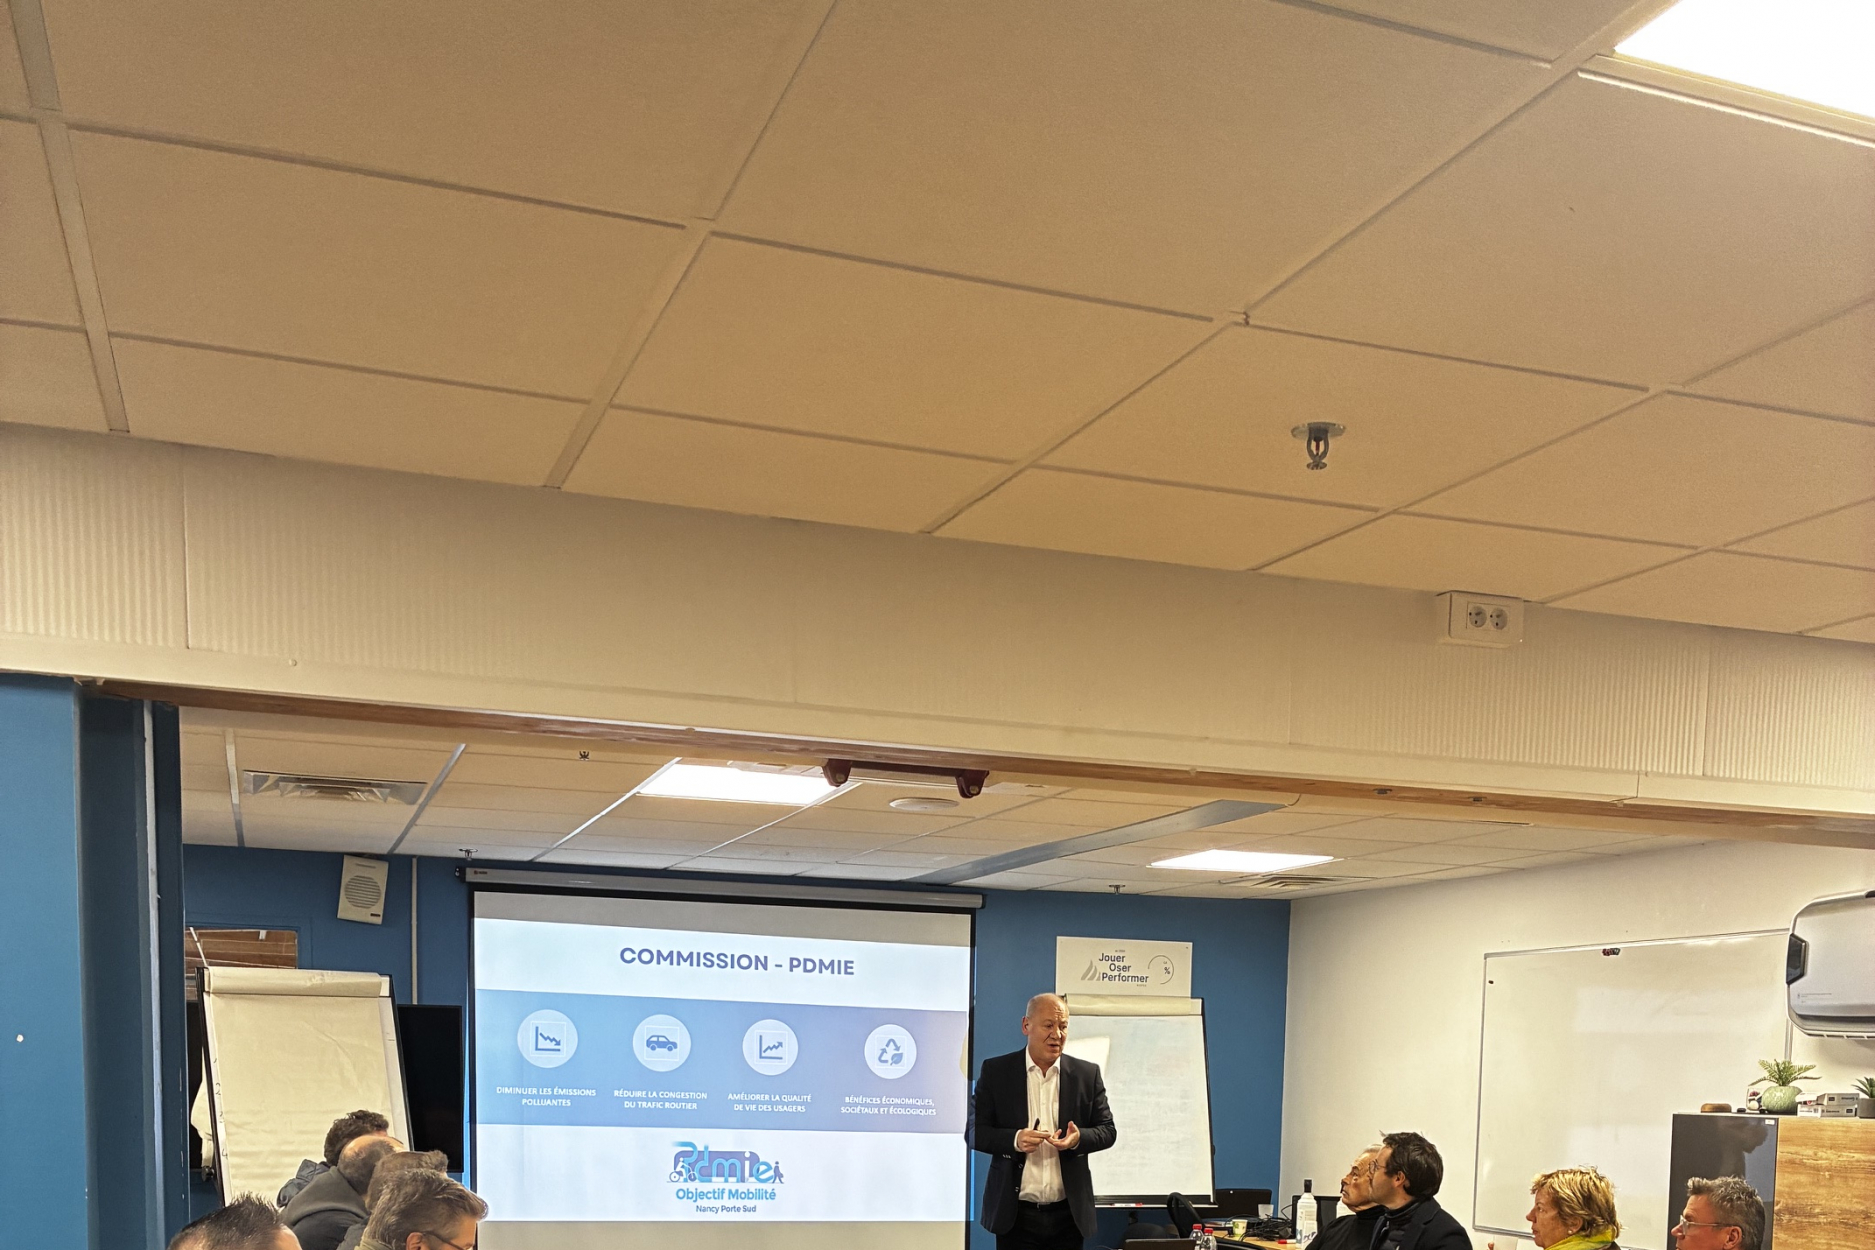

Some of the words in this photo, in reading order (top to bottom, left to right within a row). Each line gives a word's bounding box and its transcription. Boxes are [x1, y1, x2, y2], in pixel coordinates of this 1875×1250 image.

[619, 947, 769, 971] COMMISSION
[789, 957, 855, 976] PDMIE
[1098, 952, 1126, 963] Jouer
[1109, 963, 1132, 973] Oser
[1102, 972, 1149, 983] Performer
[496, 1086, 538, 1095] DIMINUER
[539, 1087, 552, 1095] LES
[553, 1086, 597, 1096] ÉMISSIONS
[614, 1088, 647, 1098] RÉDUIRE
[648, 1090, 658, 1098] LA
[659, 1091, 708, 1099] CONGESTION
[522, 1098, 571, 1107] POLLUANTES
[727, 1092, 770, 1101] AMÉLIORER
[771, 1094, 781, 1102] LA
[781, 1094, 812, 1103] QUALITÉ
[845, 1095, 881, 1104] BÉNÉFICES
[637, 1101, 664, 1109] TRAFIC
[664, 1102, 698, 1110] ROUTIER
[758, 1104, 772, 1112] DES
[773, 1105, 806, 1113] USAGERS
[840, 1105, 879, 1114] SOCIÉTAUX
[880, 1107, 888, 1115] ET
[889, 1106, 937, 1116] ÉCOLOGIQUES
[675, 1188, 726, 1203] Objectif
[728, 1188, 776, 1200] Mobilité
[696, 1205, 719, 1214] Nancy
